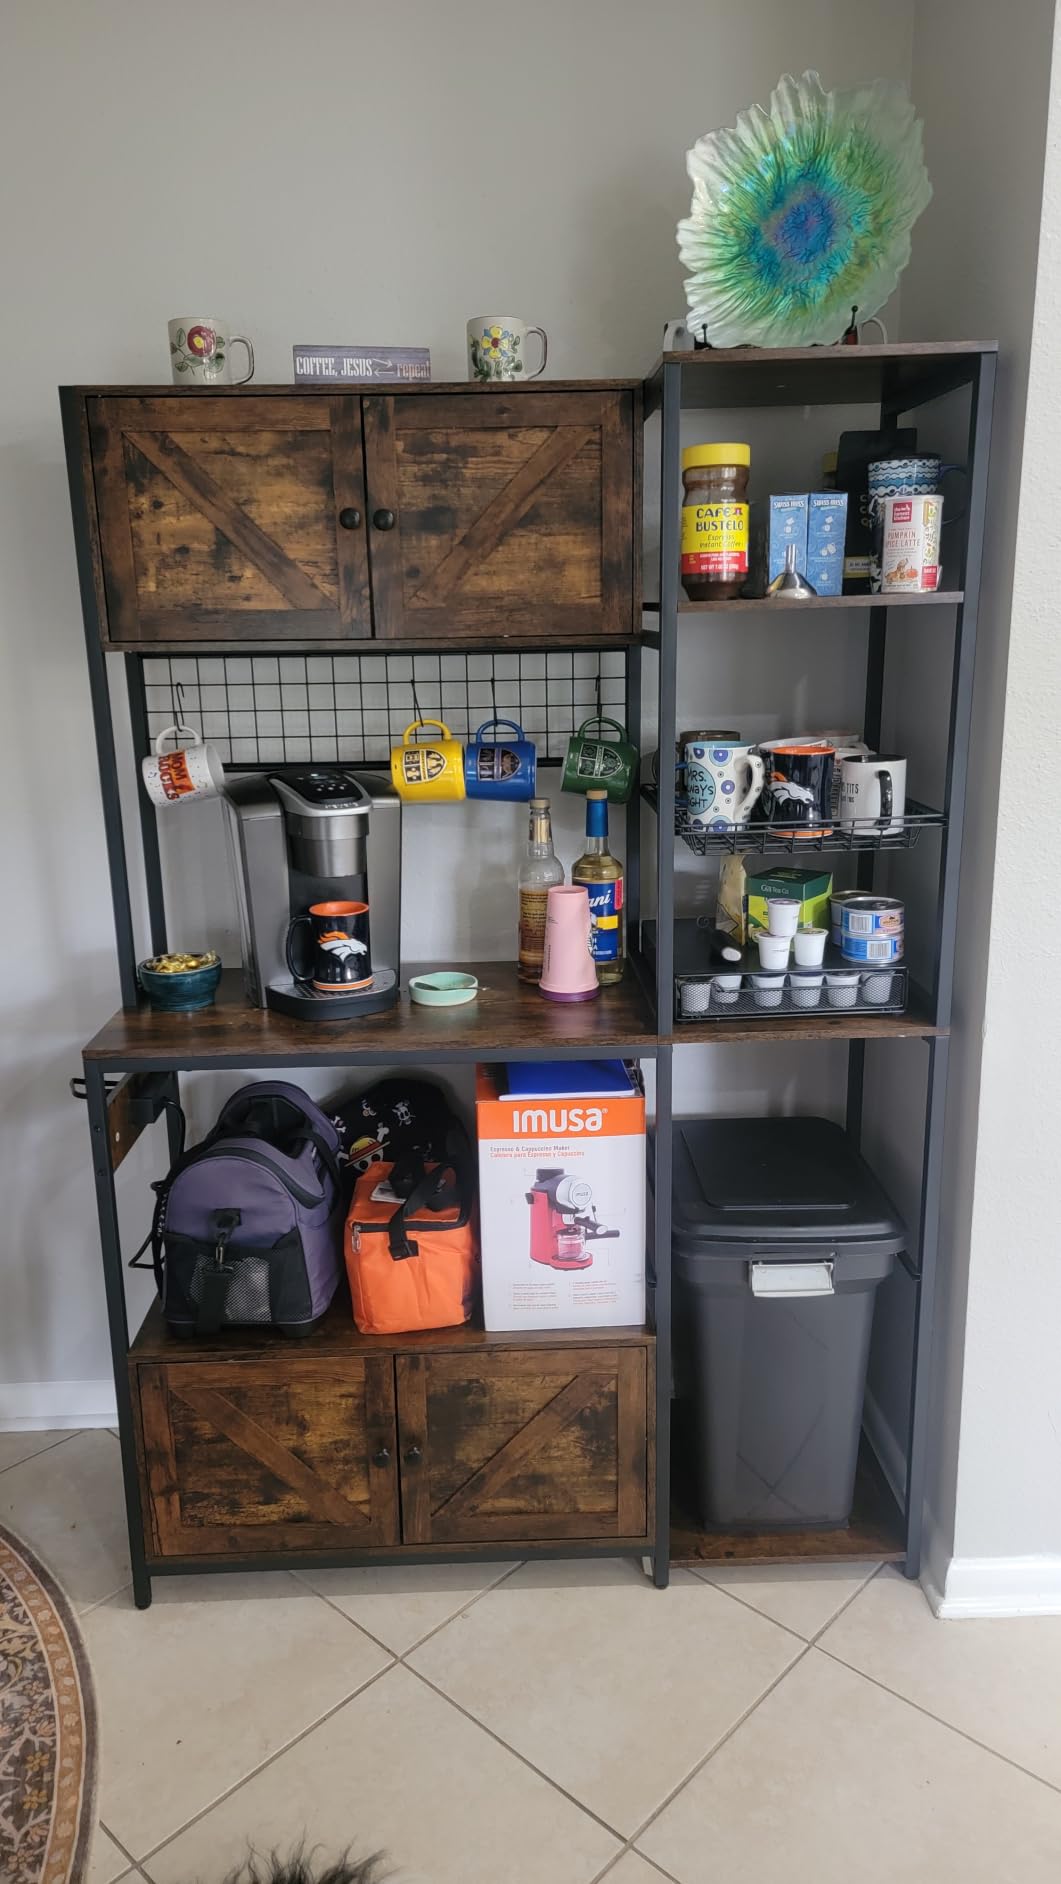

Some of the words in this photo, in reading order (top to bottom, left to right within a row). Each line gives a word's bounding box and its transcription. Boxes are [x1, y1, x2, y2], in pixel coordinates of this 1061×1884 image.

[296, 357, 338, 376] COFFEE,
[341, 358, 373, 376] JESUS
[813, 499, 829, 507] SWISS
[696, 520, 744, 532] BUSTELO
[888, 531, 916, 540] PUMPKIN
[901, 539, 921, 548] LATTE
[846, 783, 859, 794] TITS
[773, 886, 781, 894] Tea
